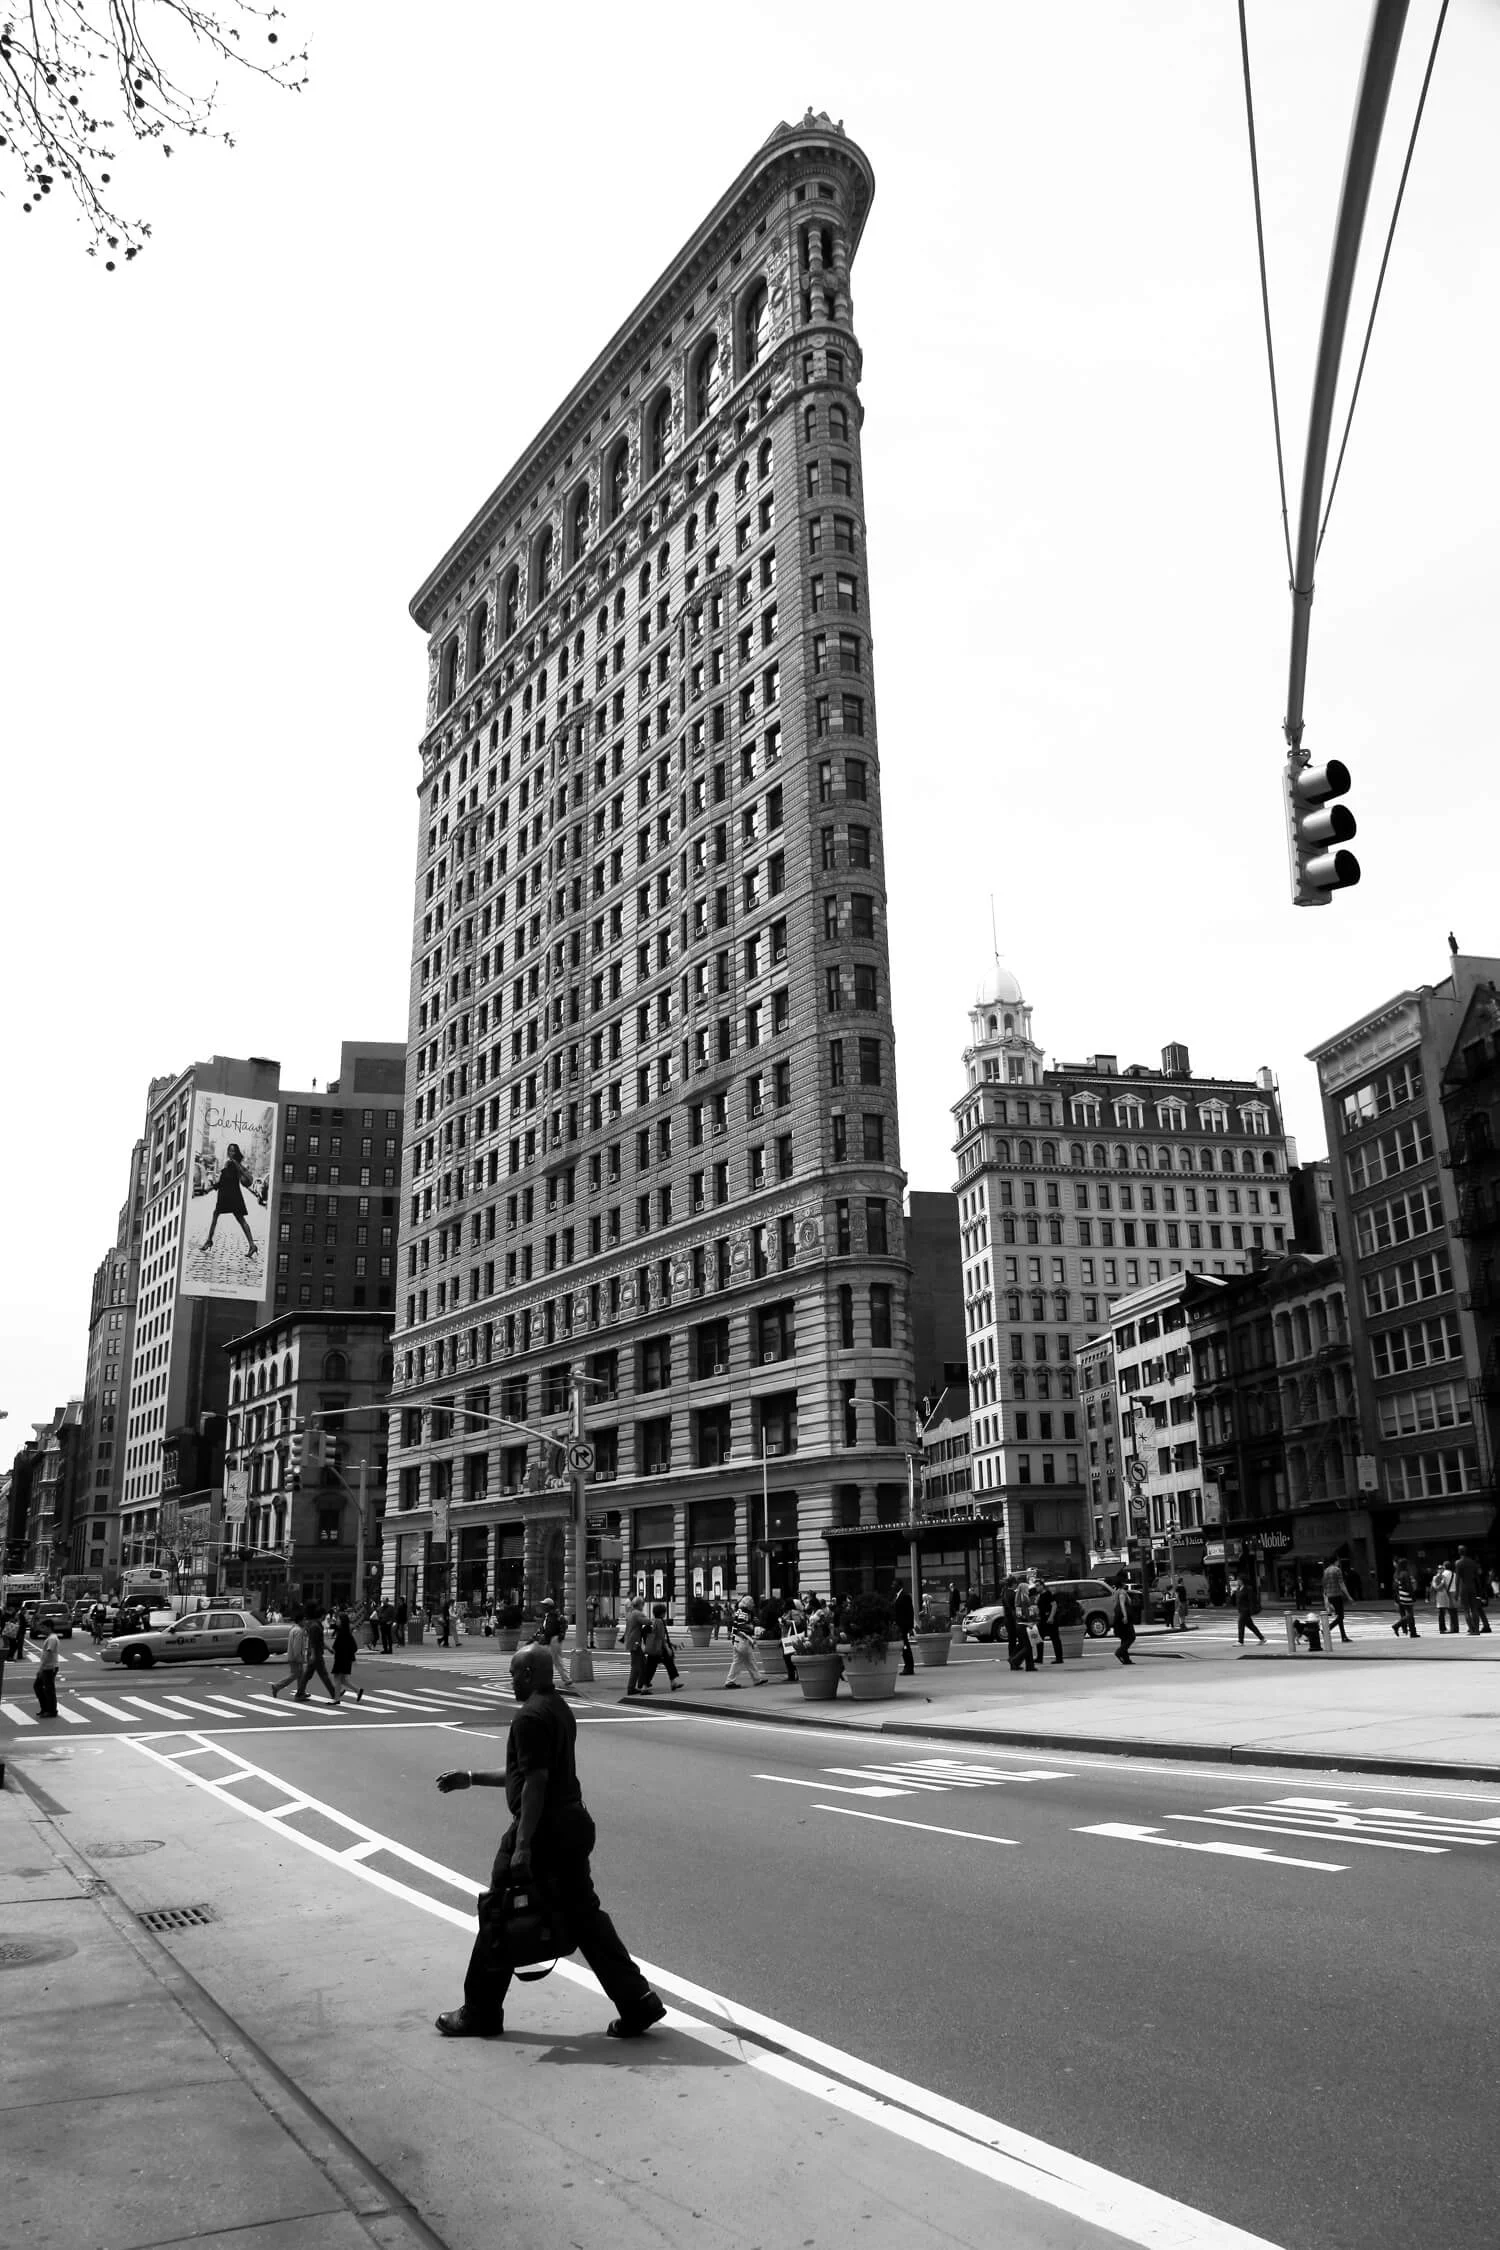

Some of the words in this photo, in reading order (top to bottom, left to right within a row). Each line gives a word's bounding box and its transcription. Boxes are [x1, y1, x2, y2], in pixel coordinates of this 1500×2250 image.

[205, 1107, 231, 1129] Cole
[231, 1109, 264, 1133] Haan
[1260, 1531, 1287, 1548] Mobile
[751, 1759, 1079, 1797] LANE
[1072, 1797, 1500, 1872] FIRE
